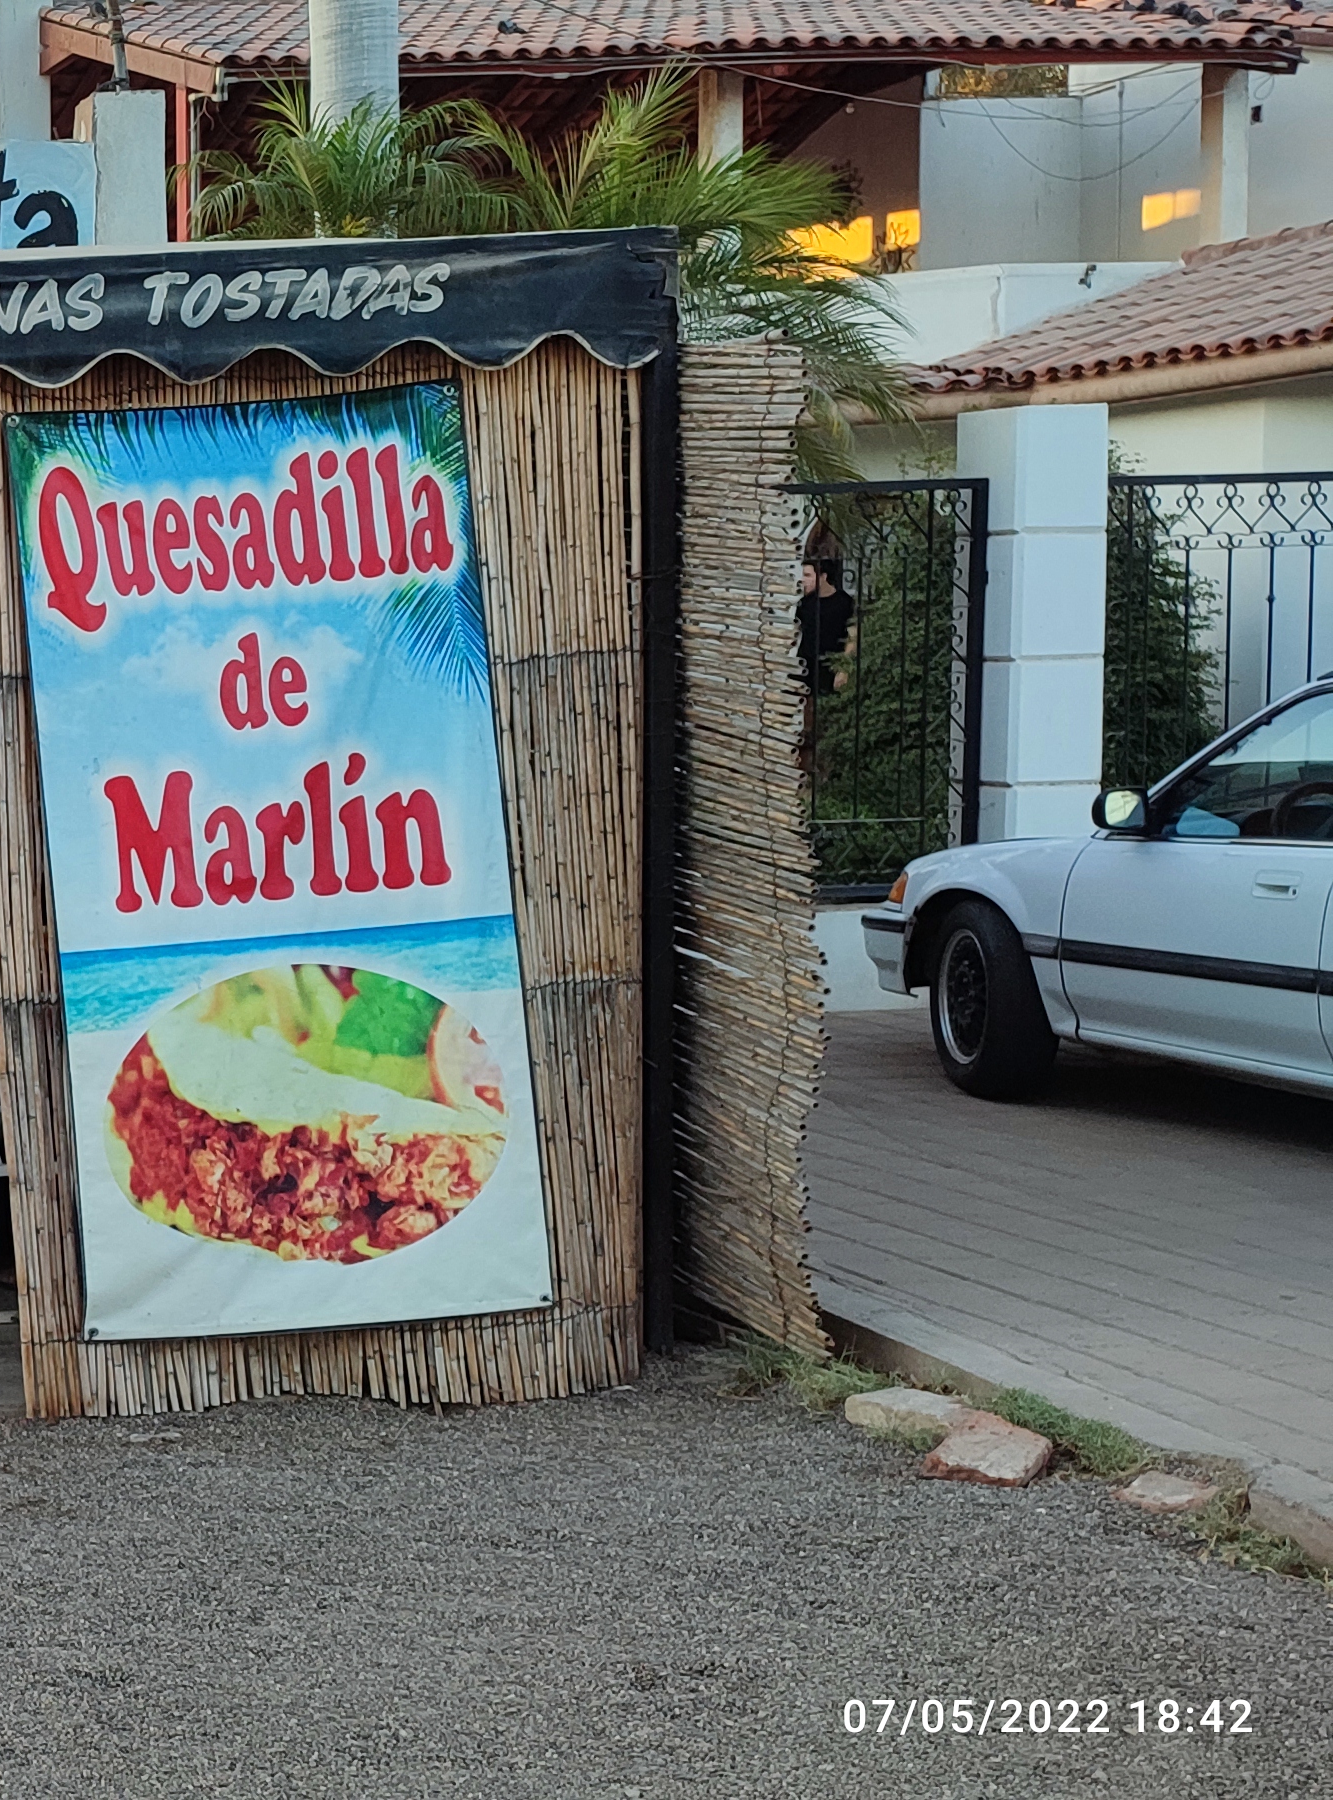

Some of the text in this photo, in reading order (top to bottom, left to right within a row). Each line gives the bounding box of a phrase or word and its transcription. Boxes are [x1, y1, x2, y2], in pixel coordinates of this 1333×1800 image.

[142, 261, 451, 329] TOSTADAS
[38, 444, 454, 632] Quesadilla
[219, 631, 309, 731] de
[103, 752, 452, 913] Marlín
